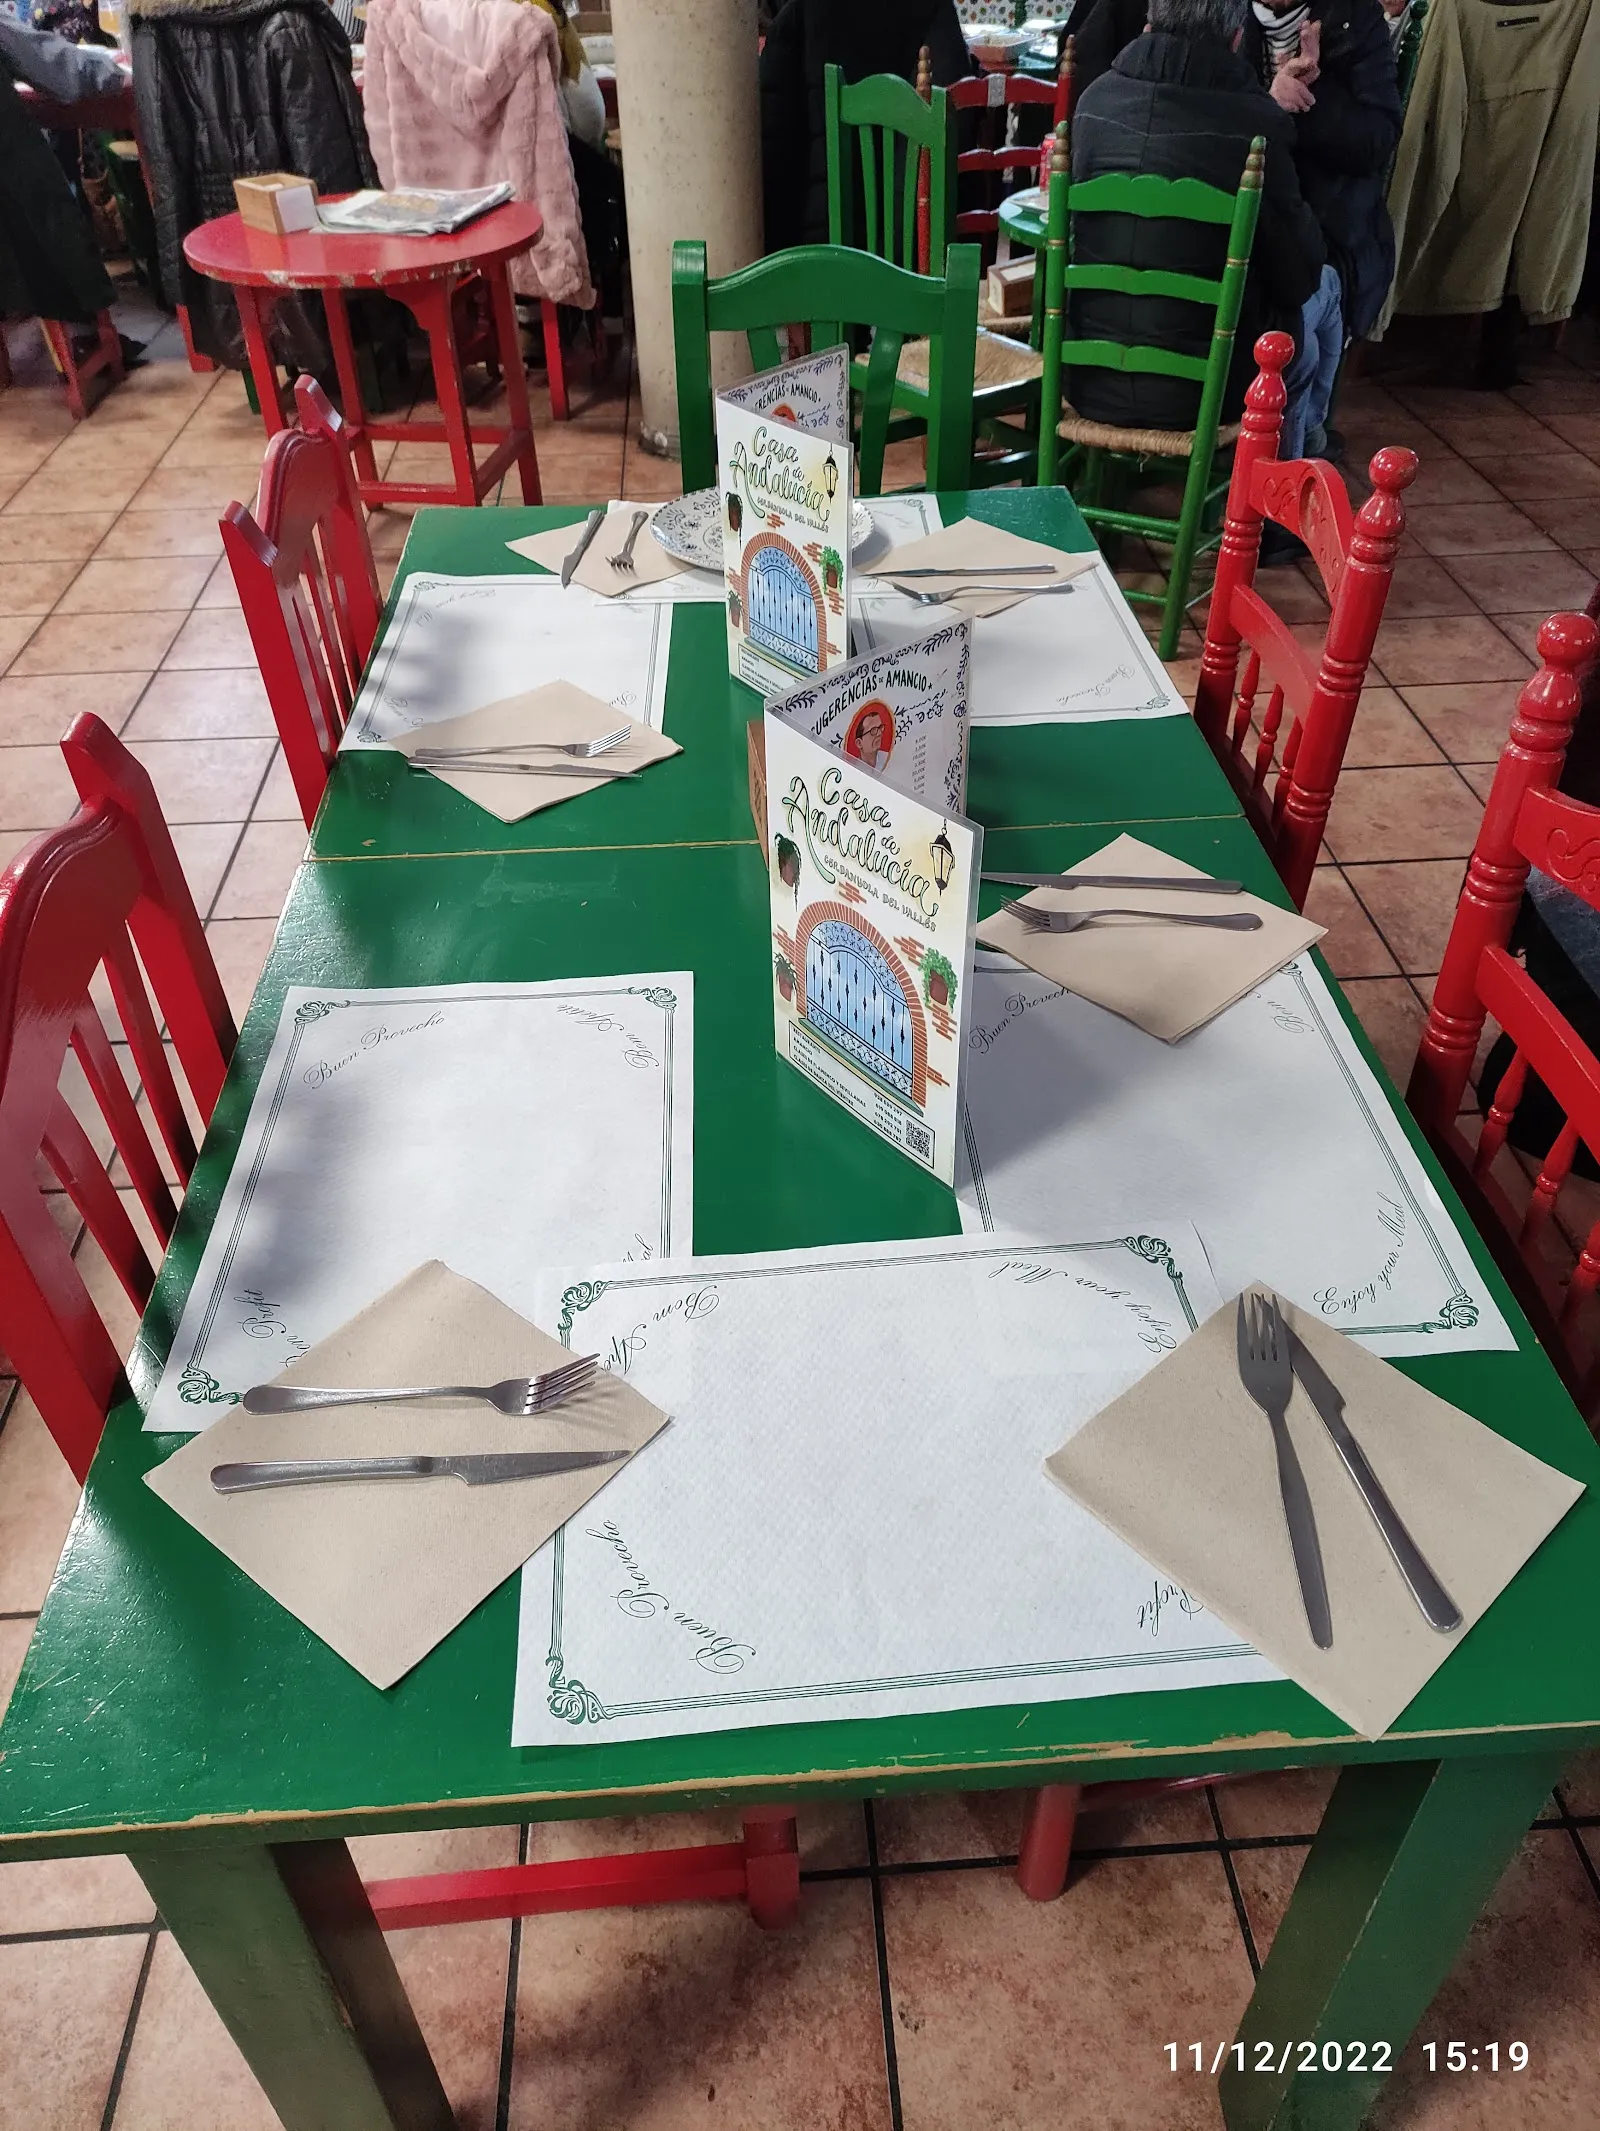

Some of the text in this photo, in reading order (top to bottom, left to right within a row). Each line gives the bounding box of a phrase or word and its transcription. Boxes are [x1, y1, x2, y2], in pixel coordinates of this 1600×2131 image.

[790, 383, 817, 403] AMANCIO
[753, 426, 798, 462] Casa
[793, 467, 804, 481] de
[729, 441, 830, 521] Andalucía
[885, 669, 926, 692] AMANCIO
[821, 767, 891, 827] Casa
[782, 776, 939, 917] Andalucía
[881, 836, 900, 855] de
[824, 855, 879, 899] CERDANYOLA
[882, 893, 900, 910] DEL
[303, 1011, 445, 1090] Buen Provecho
[968, 987, 1070, 1054] Buen Provech
[1313, 1191, 1406, 1315] Enjoy your Meal
[234, 1289, 286, 1338] Profit
[600, 1285, 719, 1375] Bom Ape
[988, 1261, 1177, 1353] Enjoy your Meal
[585, 1519, 756, 1674] Buen Provecho
